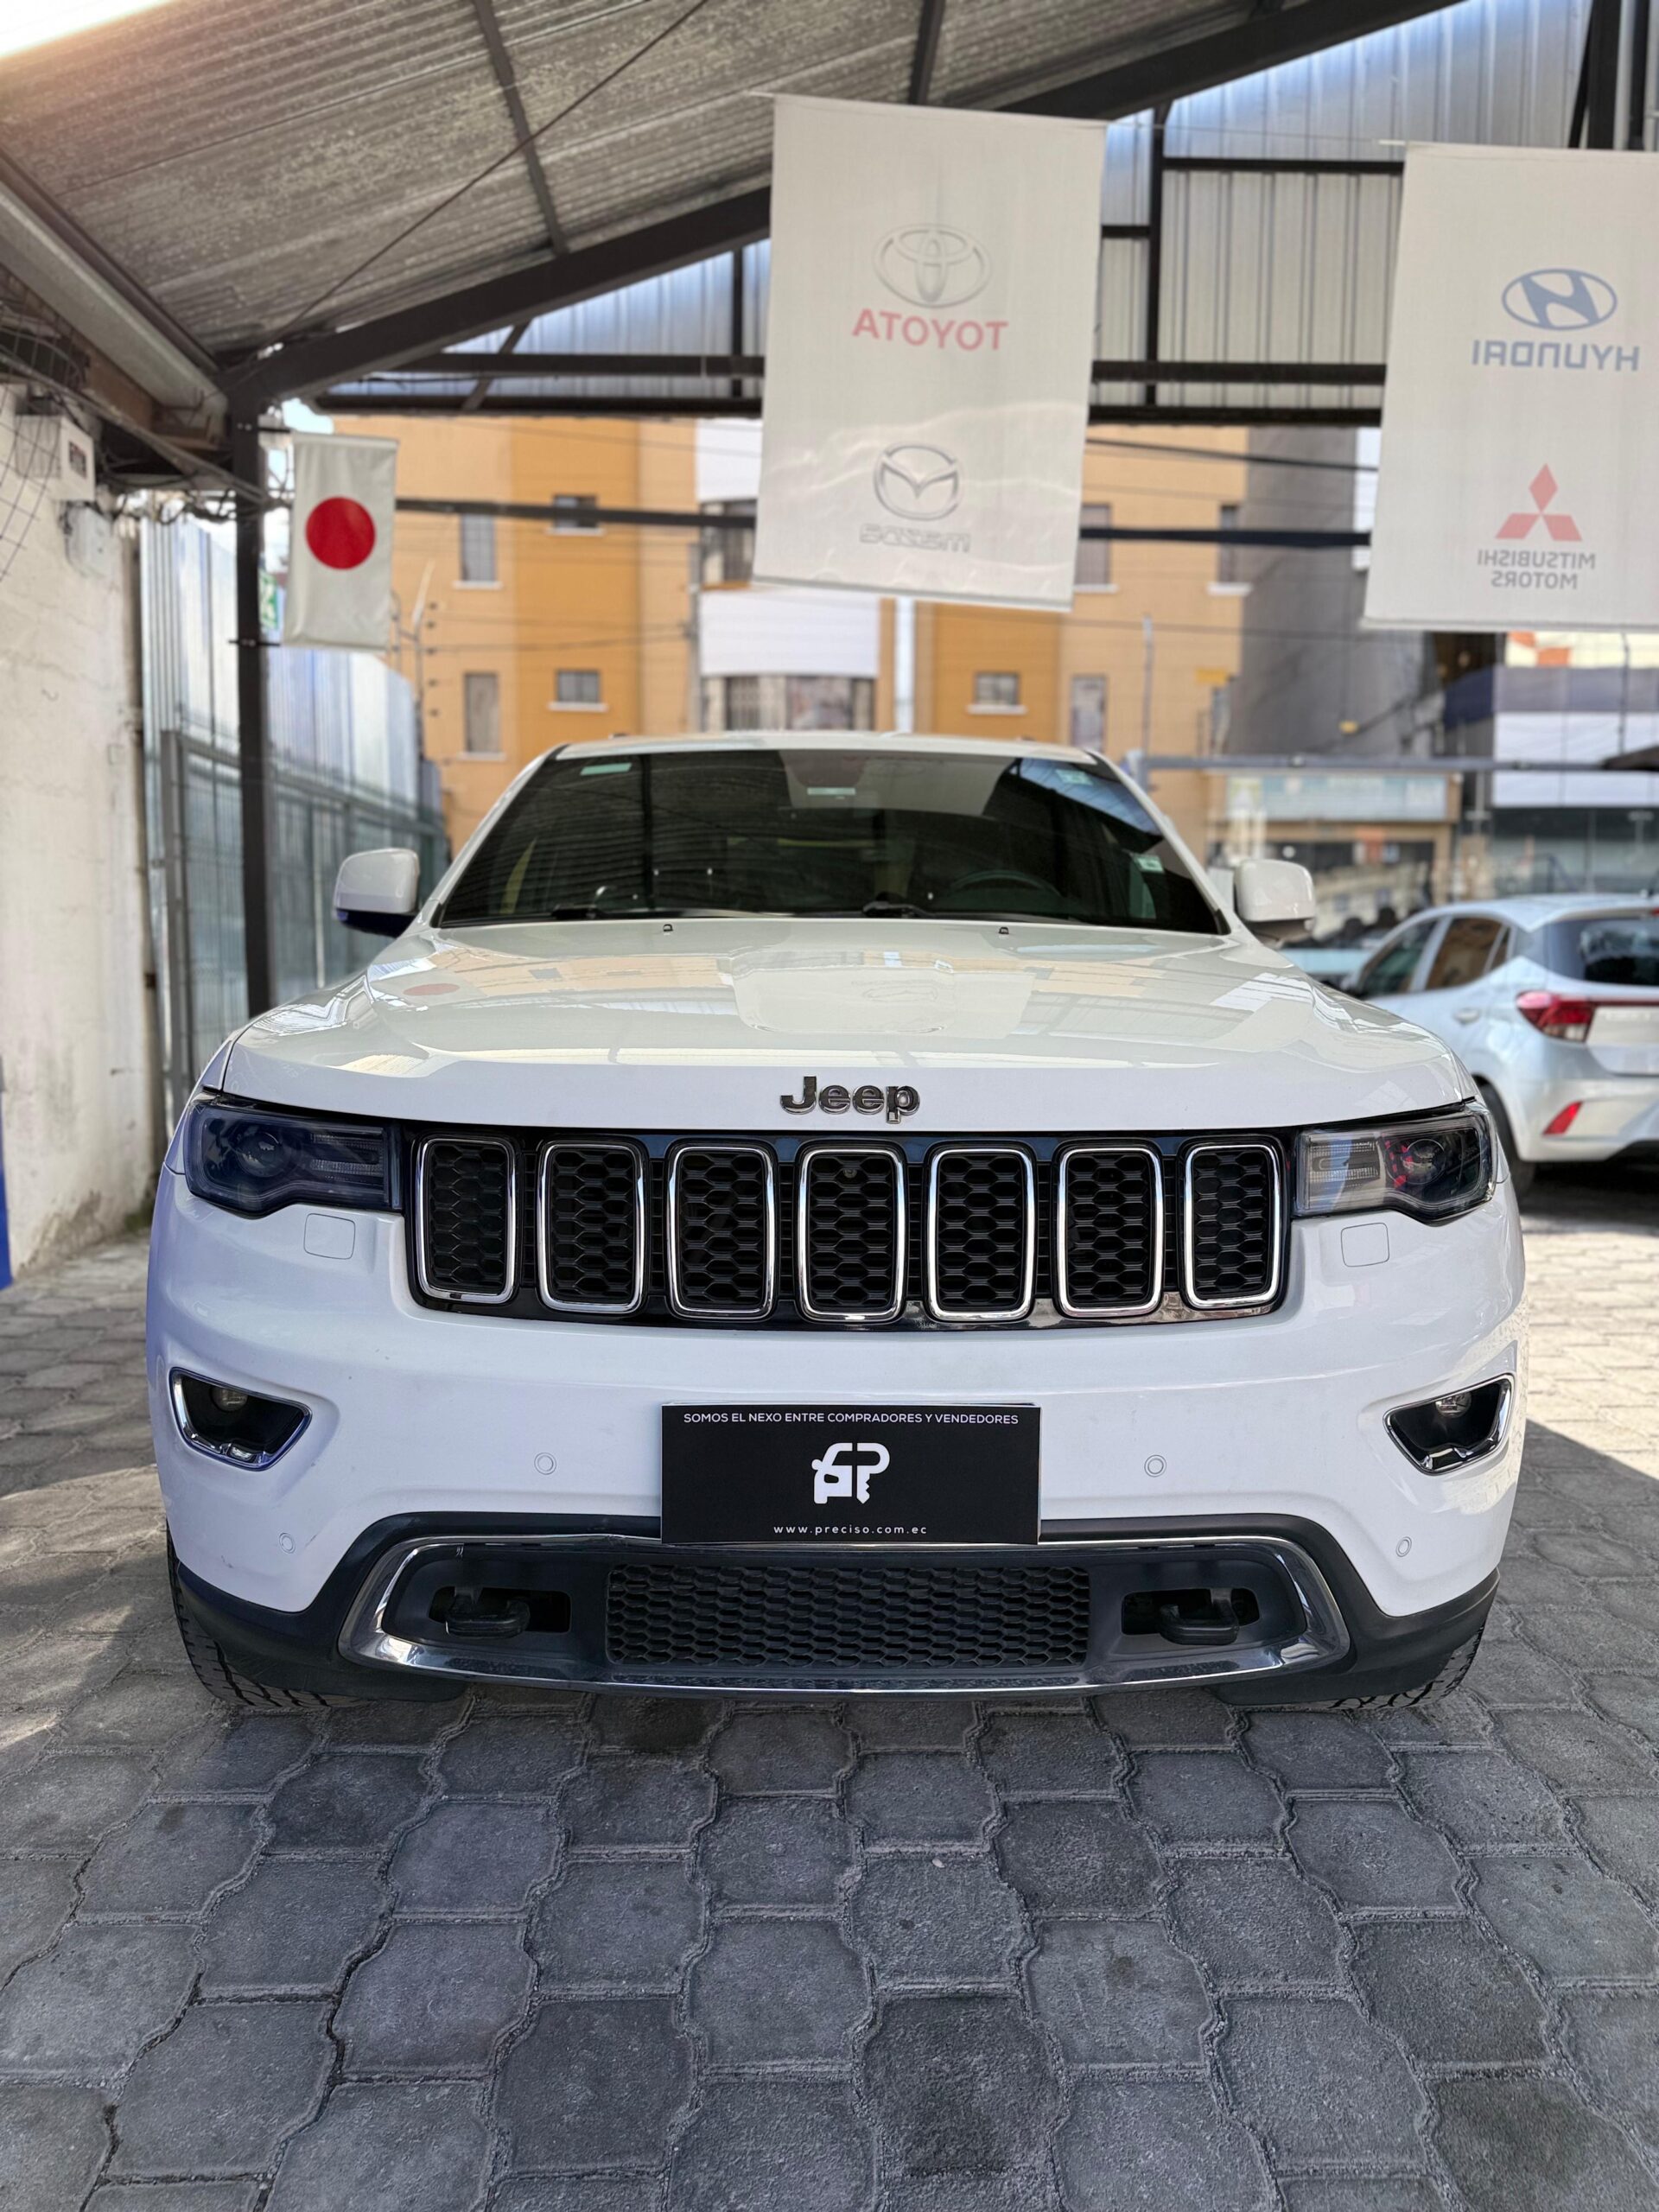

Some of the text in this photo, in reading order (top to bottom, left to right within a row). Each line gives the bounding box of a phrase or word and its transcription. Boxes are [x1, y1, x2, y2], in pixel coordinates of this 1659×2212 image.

[780, 1075, 921, 1124] Jeep
[683, 1413, 1019, 1425] SOMOS EL NEXO ENTRE COMPRADORES Y VENDEDORES
[773, 1524, 927, 1535] www.preciso.com.ec
